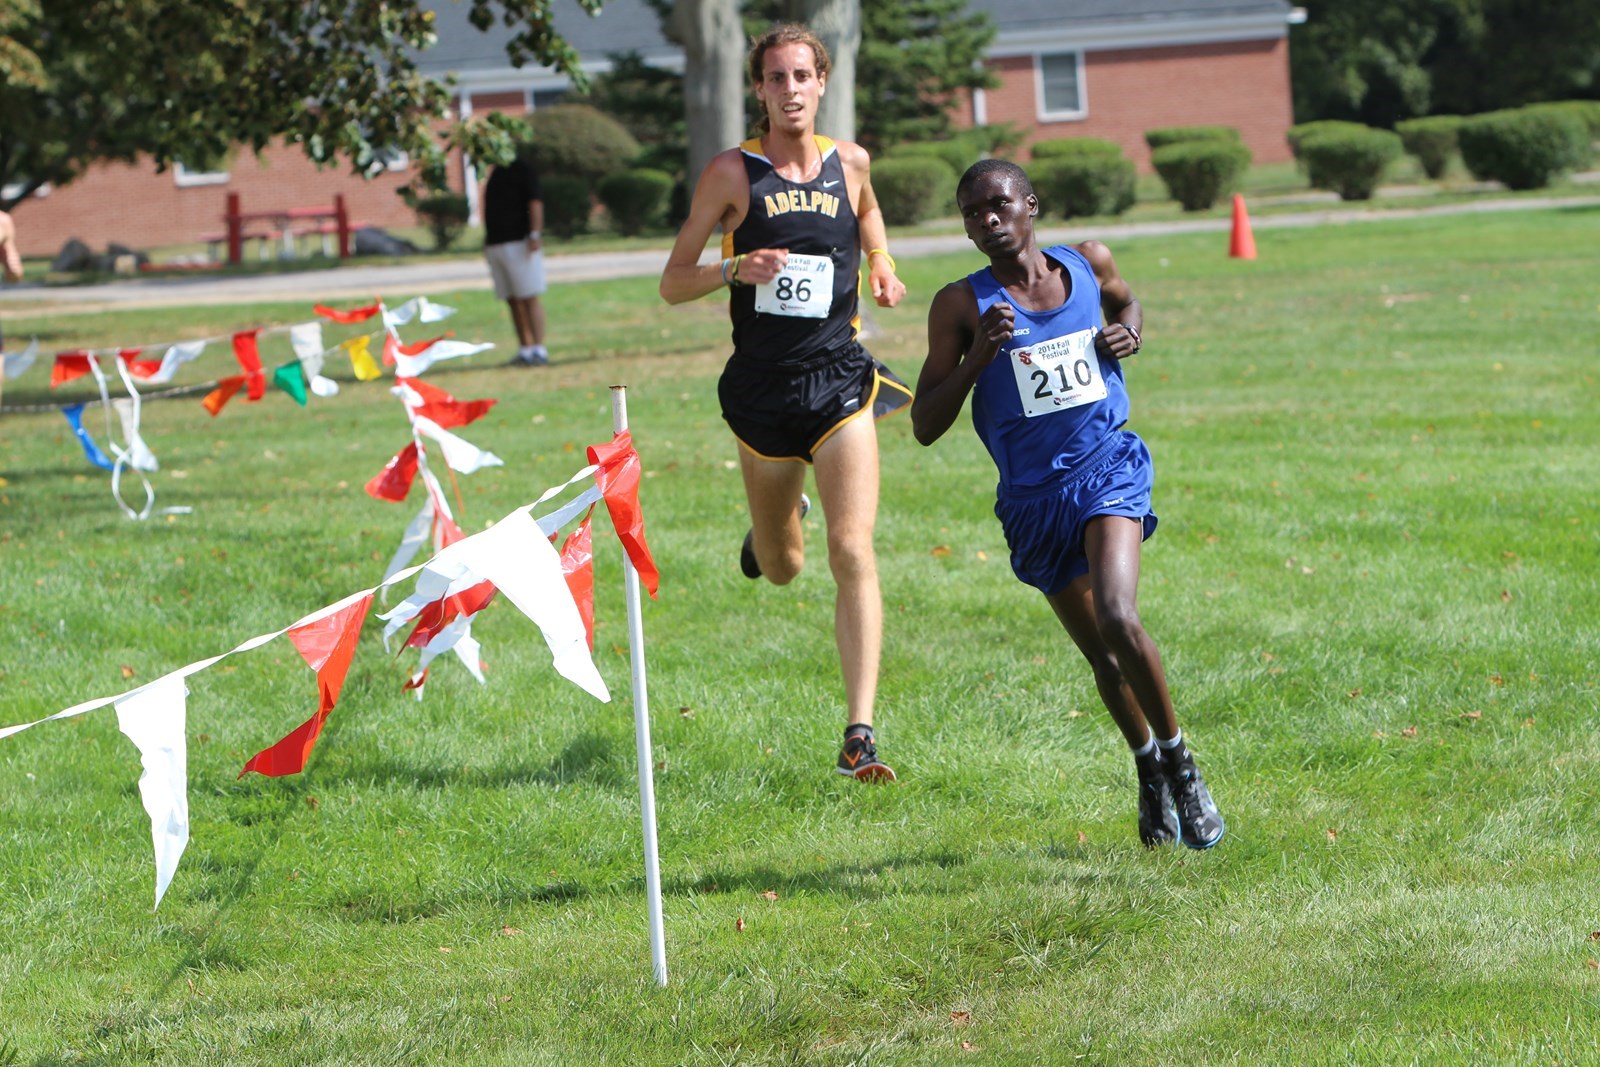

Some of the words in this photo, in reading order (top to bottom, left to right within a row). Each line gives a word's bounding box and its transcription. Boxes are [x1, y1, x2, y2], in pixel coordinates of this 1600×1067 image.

[764, 190, 840, 218] ADELPHI
[776, 277, 811, 302] 86
[1038, 344, 1055, 354] 2014
[1057, 339, 1070, 349] Fall
[1042, 348, 1070, 360] Festival
[1030, 358, 1092, 399] 210
